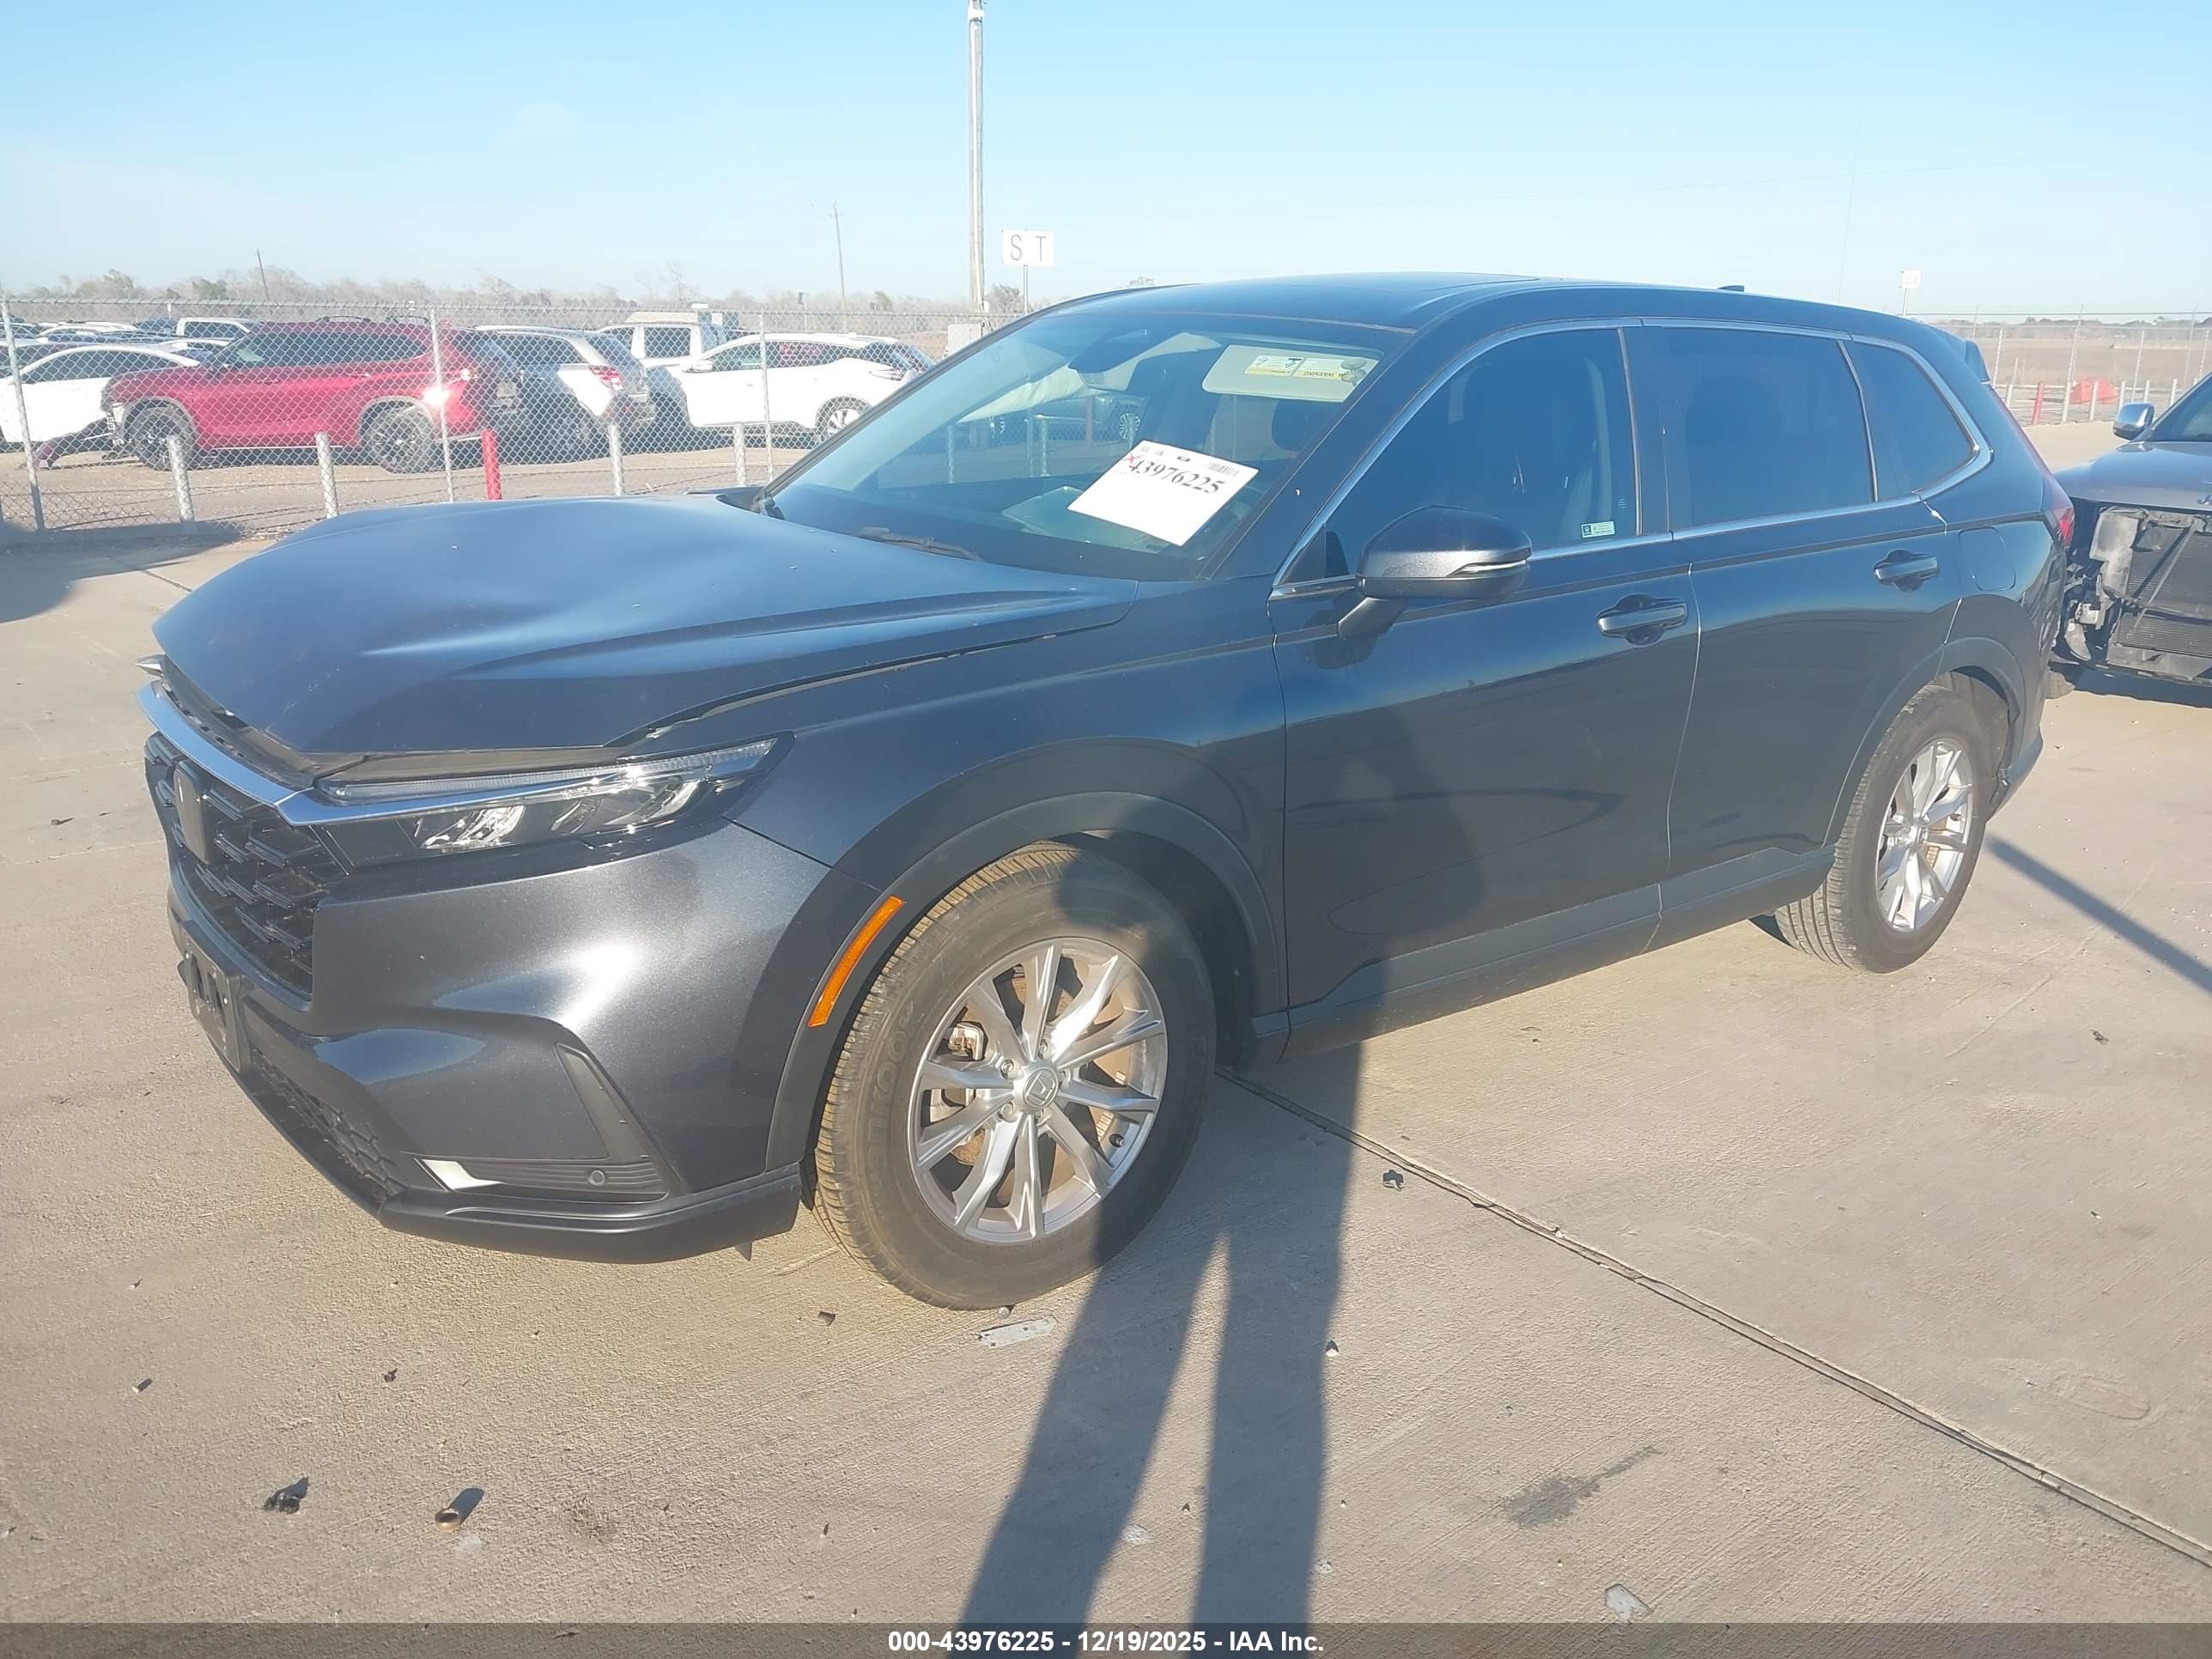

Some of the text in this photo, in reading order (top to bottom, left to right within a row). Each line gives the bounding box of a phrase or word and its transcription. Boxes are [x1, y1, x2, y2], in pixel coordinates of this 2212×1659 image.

[1010, 234, 1047, 261] S T
[1127, 459, 1225, 494] 43976225
